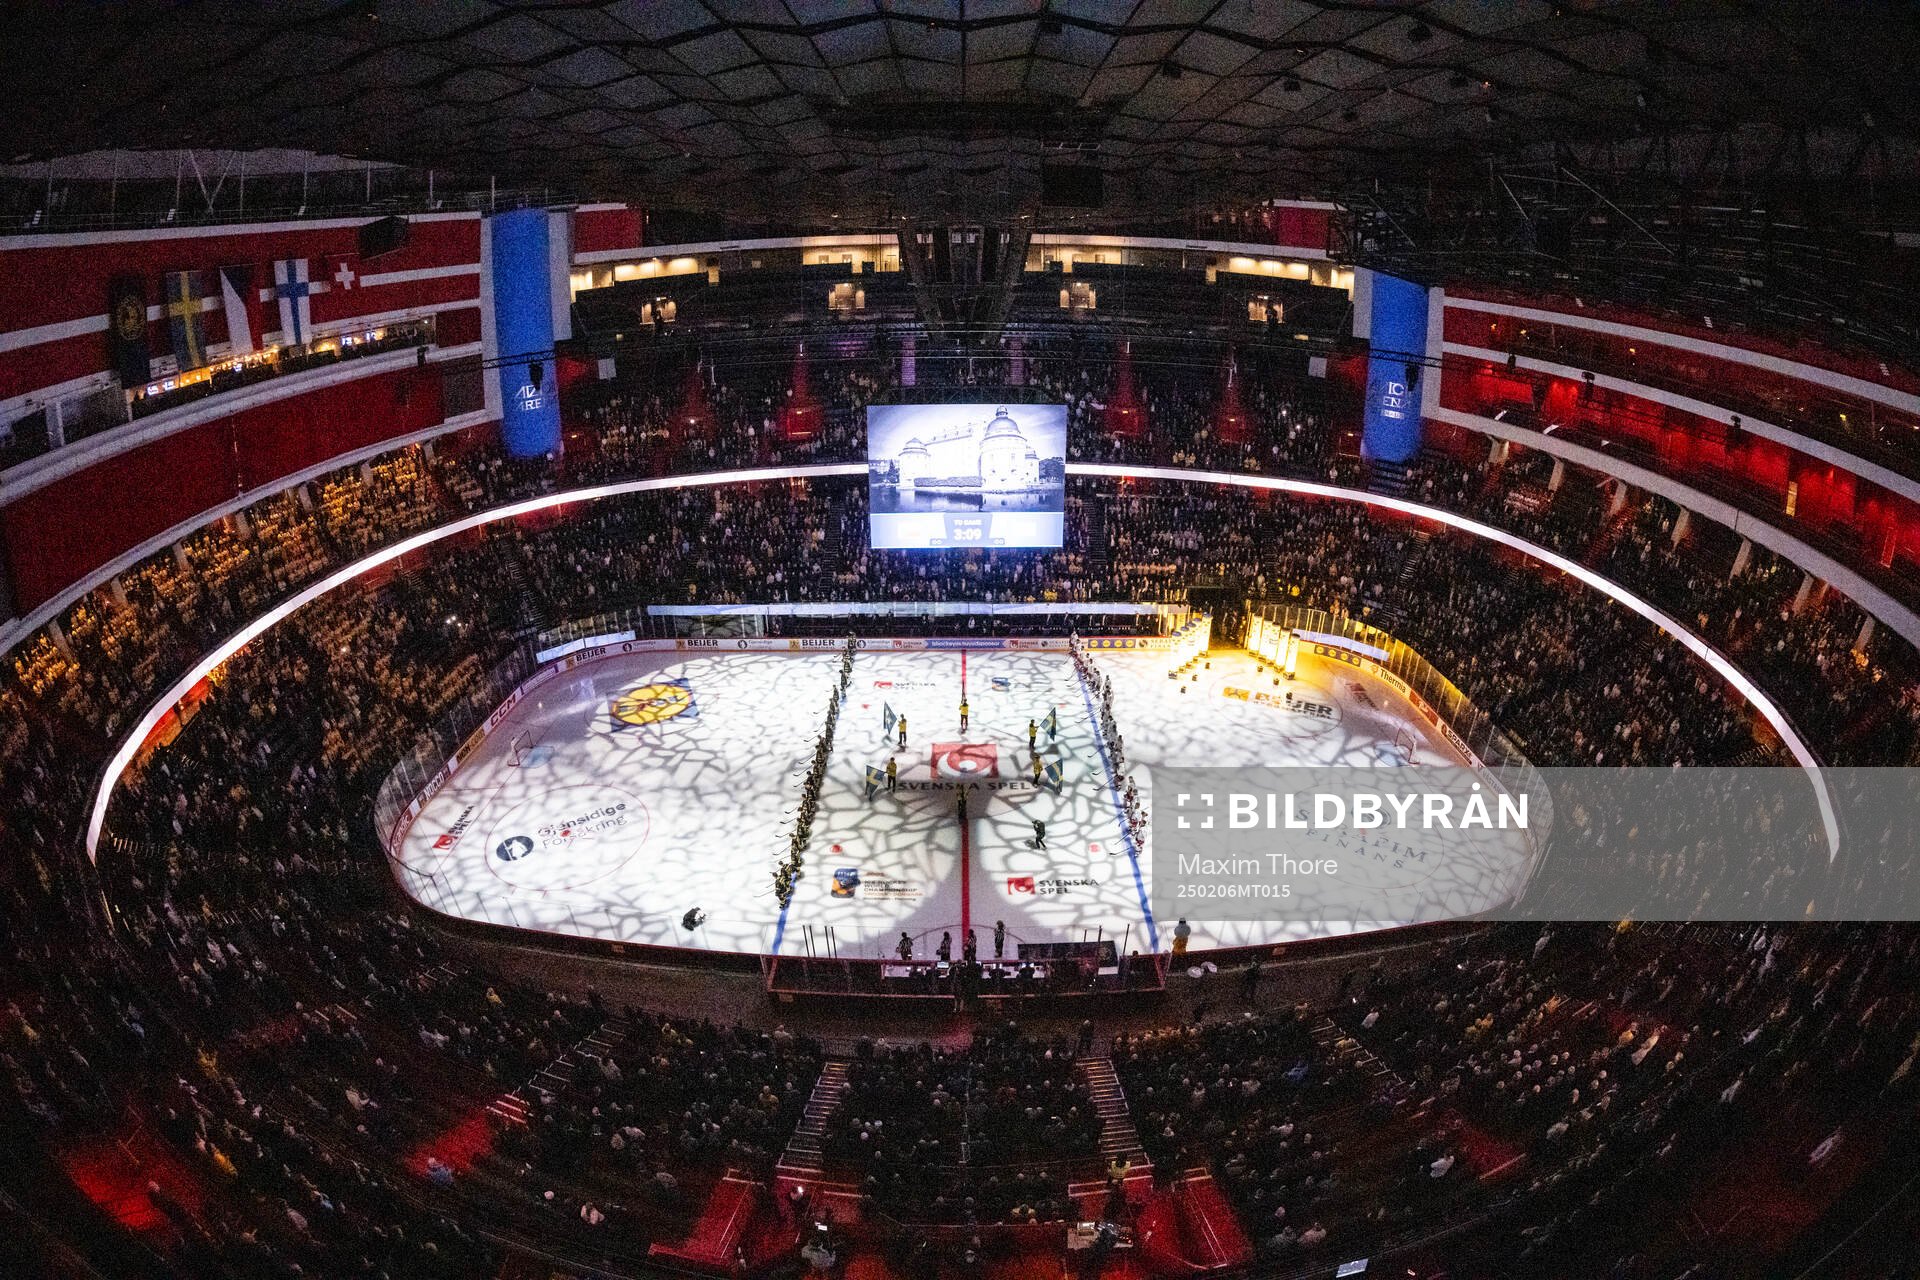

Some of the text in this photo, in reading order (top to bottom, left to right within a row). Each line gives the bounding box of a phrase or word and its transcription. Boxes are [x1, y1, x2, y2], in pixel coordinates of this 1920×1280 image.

[687, 639, 719, 647] BEIJER
[802, 639, 835, 647] BEIJER
[576, 647, 606, 662] BEIJER
[1380, 668, 1407, 693] Thermia
[490, 693, 516, 726] CCM
[987, 781, 1030, 791] SPEL
[1306, 828, 1404, 869] FINANS
[1040, 879, 1100, 887] SVENSKA
[1040, 887, 1070, 895] SPEL
